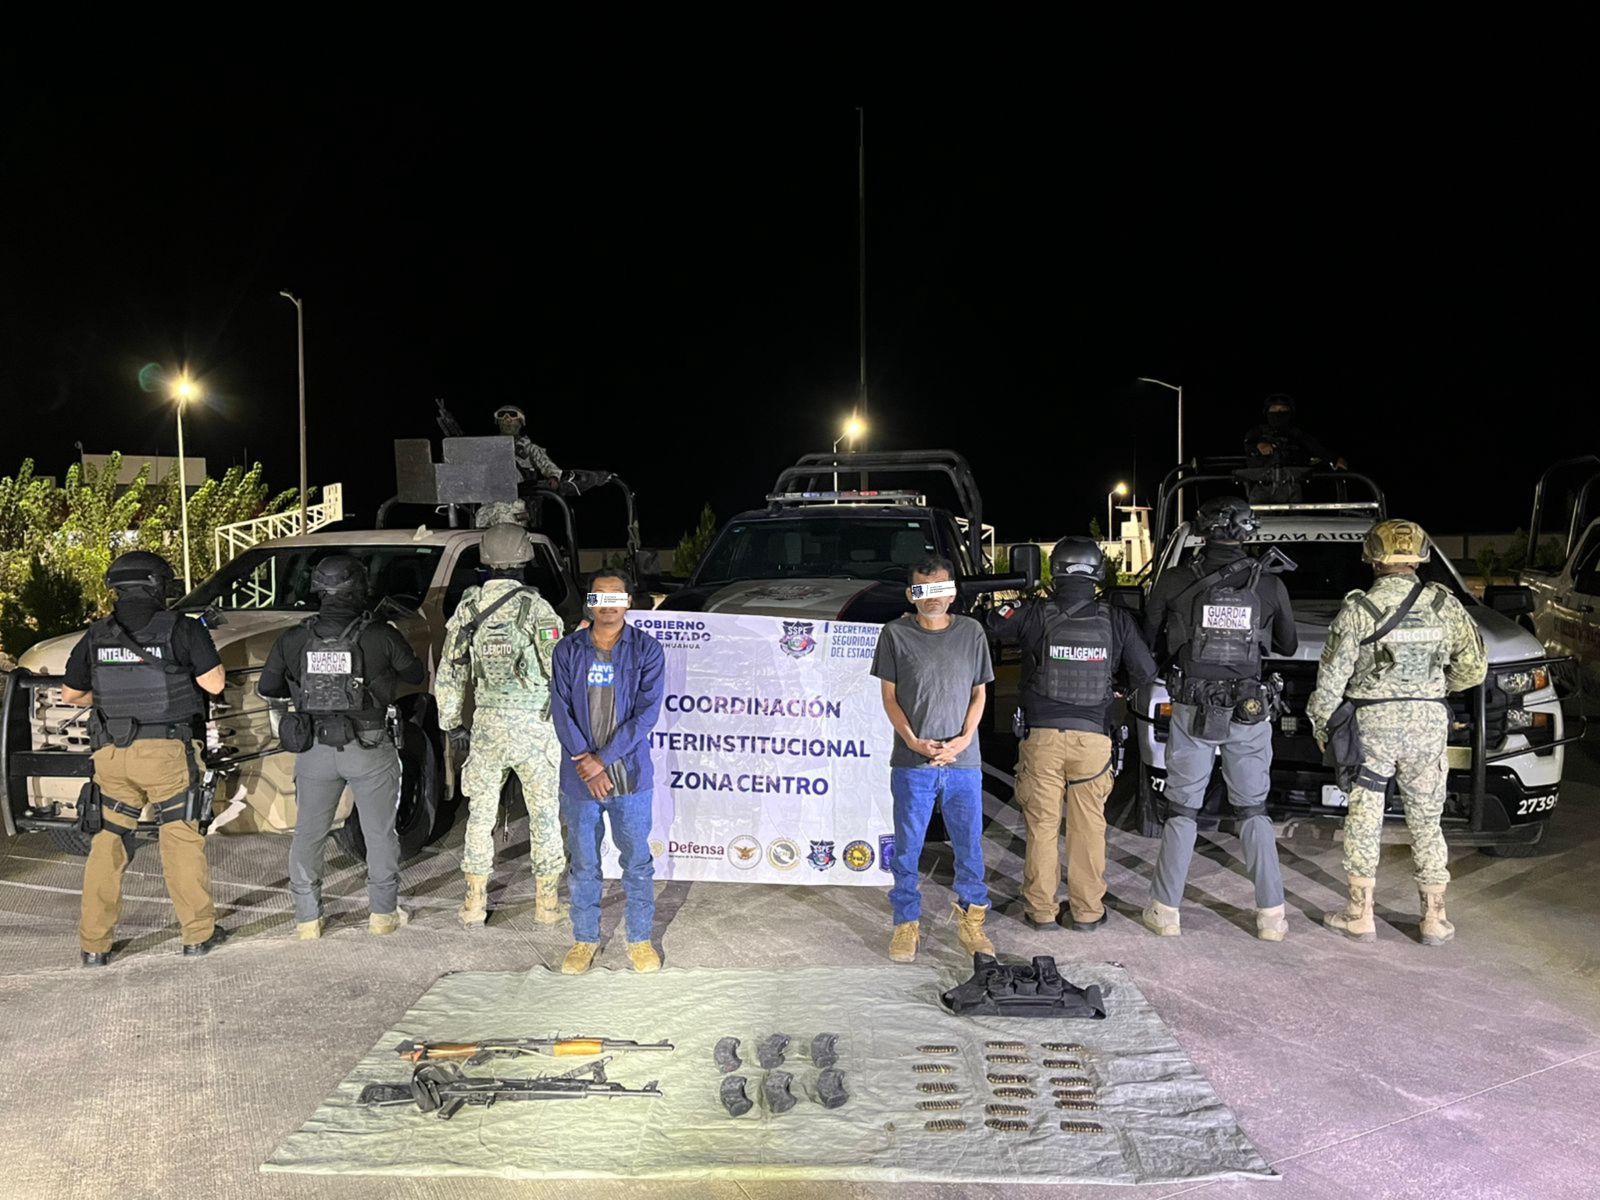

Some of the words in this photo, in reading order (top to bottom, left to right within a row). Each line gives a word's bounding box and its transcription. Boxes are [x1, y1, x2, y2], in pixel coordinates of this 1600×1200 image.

[1208, 606, 1246, 619] GUARDIA
[634, 620, 706, 630] GOBIERNO
[1207, 618, 1247, 629] NACIONAL
[656, 631, 711, 641] ESTADO
[1386, 629, 1440, 642] JERCITO
[832, 636, 876, 648] SEGURIDAD
[98, 647, 162, 661] INTELIGIA
[311, 653, 347, 663] GUARDIA
[831, 647, 845, 657] DEL
[1049, 645, 1107, 660] INTELIGENCIA
[311, 663, 347, 673] NACIONAL
[665, 694, 841, 718] COORDINACIÓN
[670, 771, 733, 792] ZONA
[737, 774, 829, 796] CENTRO
[668, 841, 725, 855] Defensa
